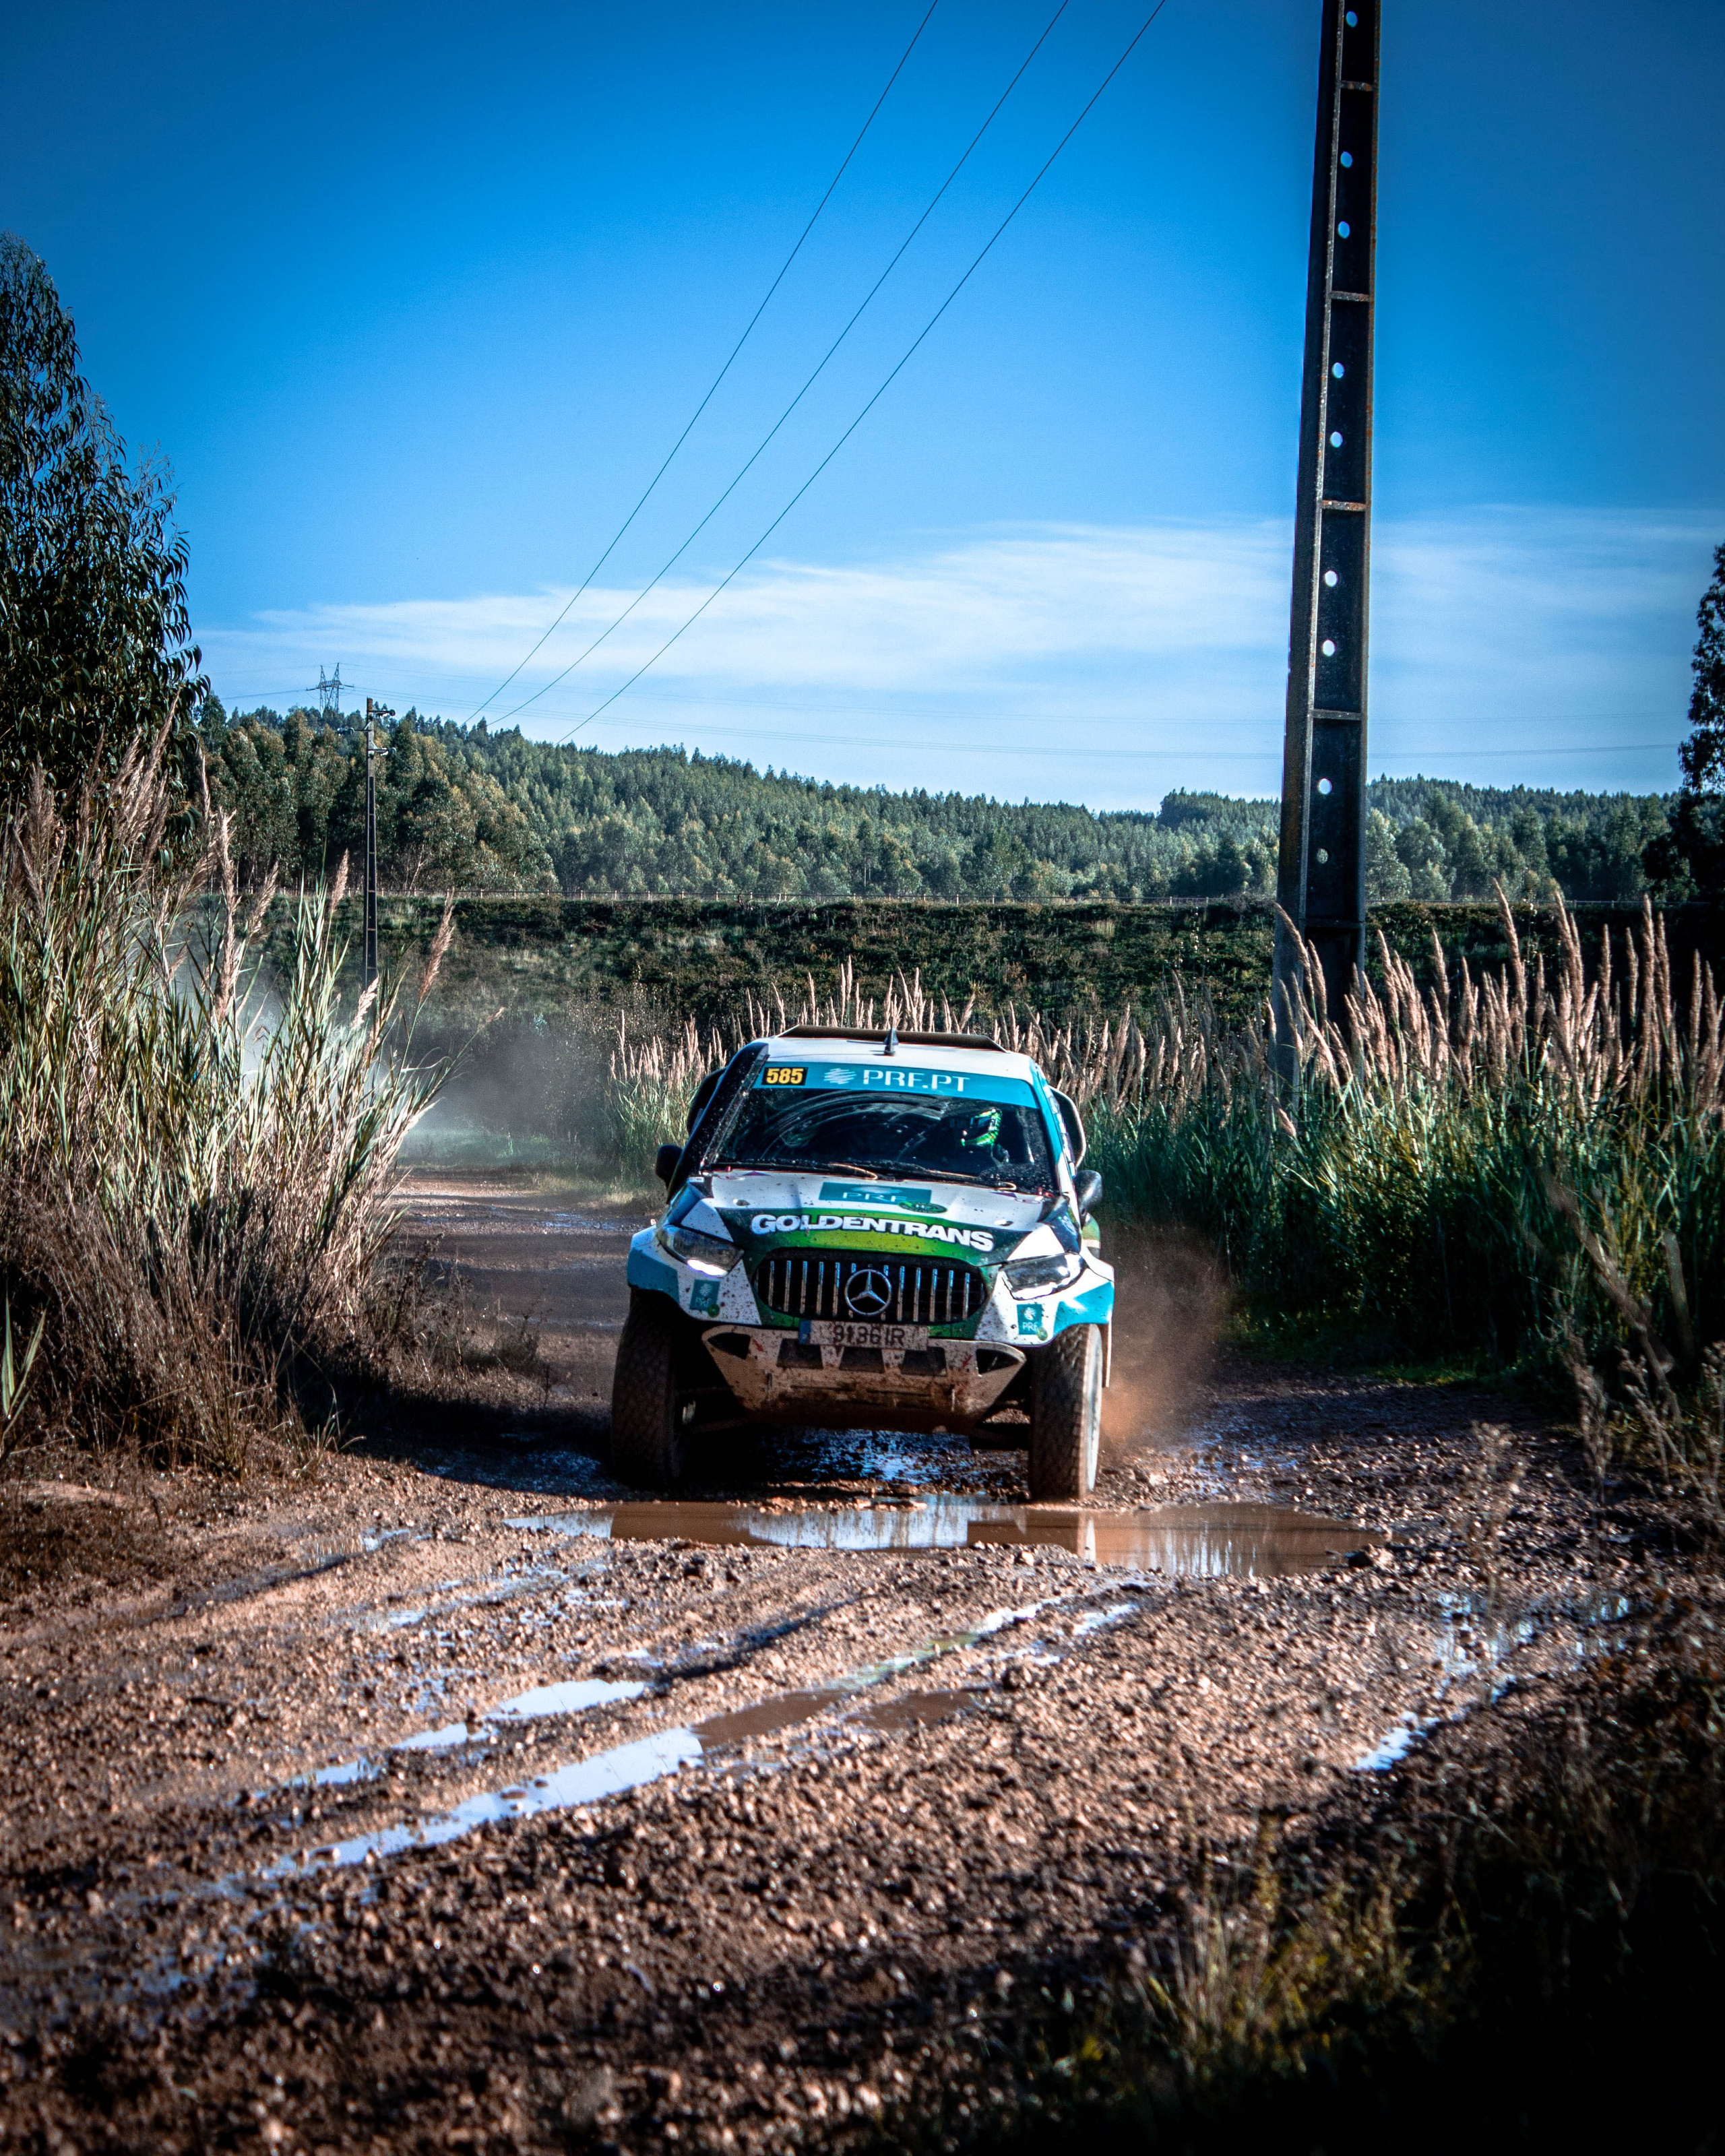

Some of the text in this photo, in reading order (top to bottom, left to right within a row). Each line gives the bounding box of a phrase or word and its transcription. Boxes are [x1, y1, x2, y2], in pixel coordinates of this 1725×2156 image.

[766, 1068, 804, 1084] 585
[863, 1069, 970, 1091] PRF.PT
[843, 1192, 907, 1203] PRF
[751, 1214, 995, 1252] GOLDENTRANS
